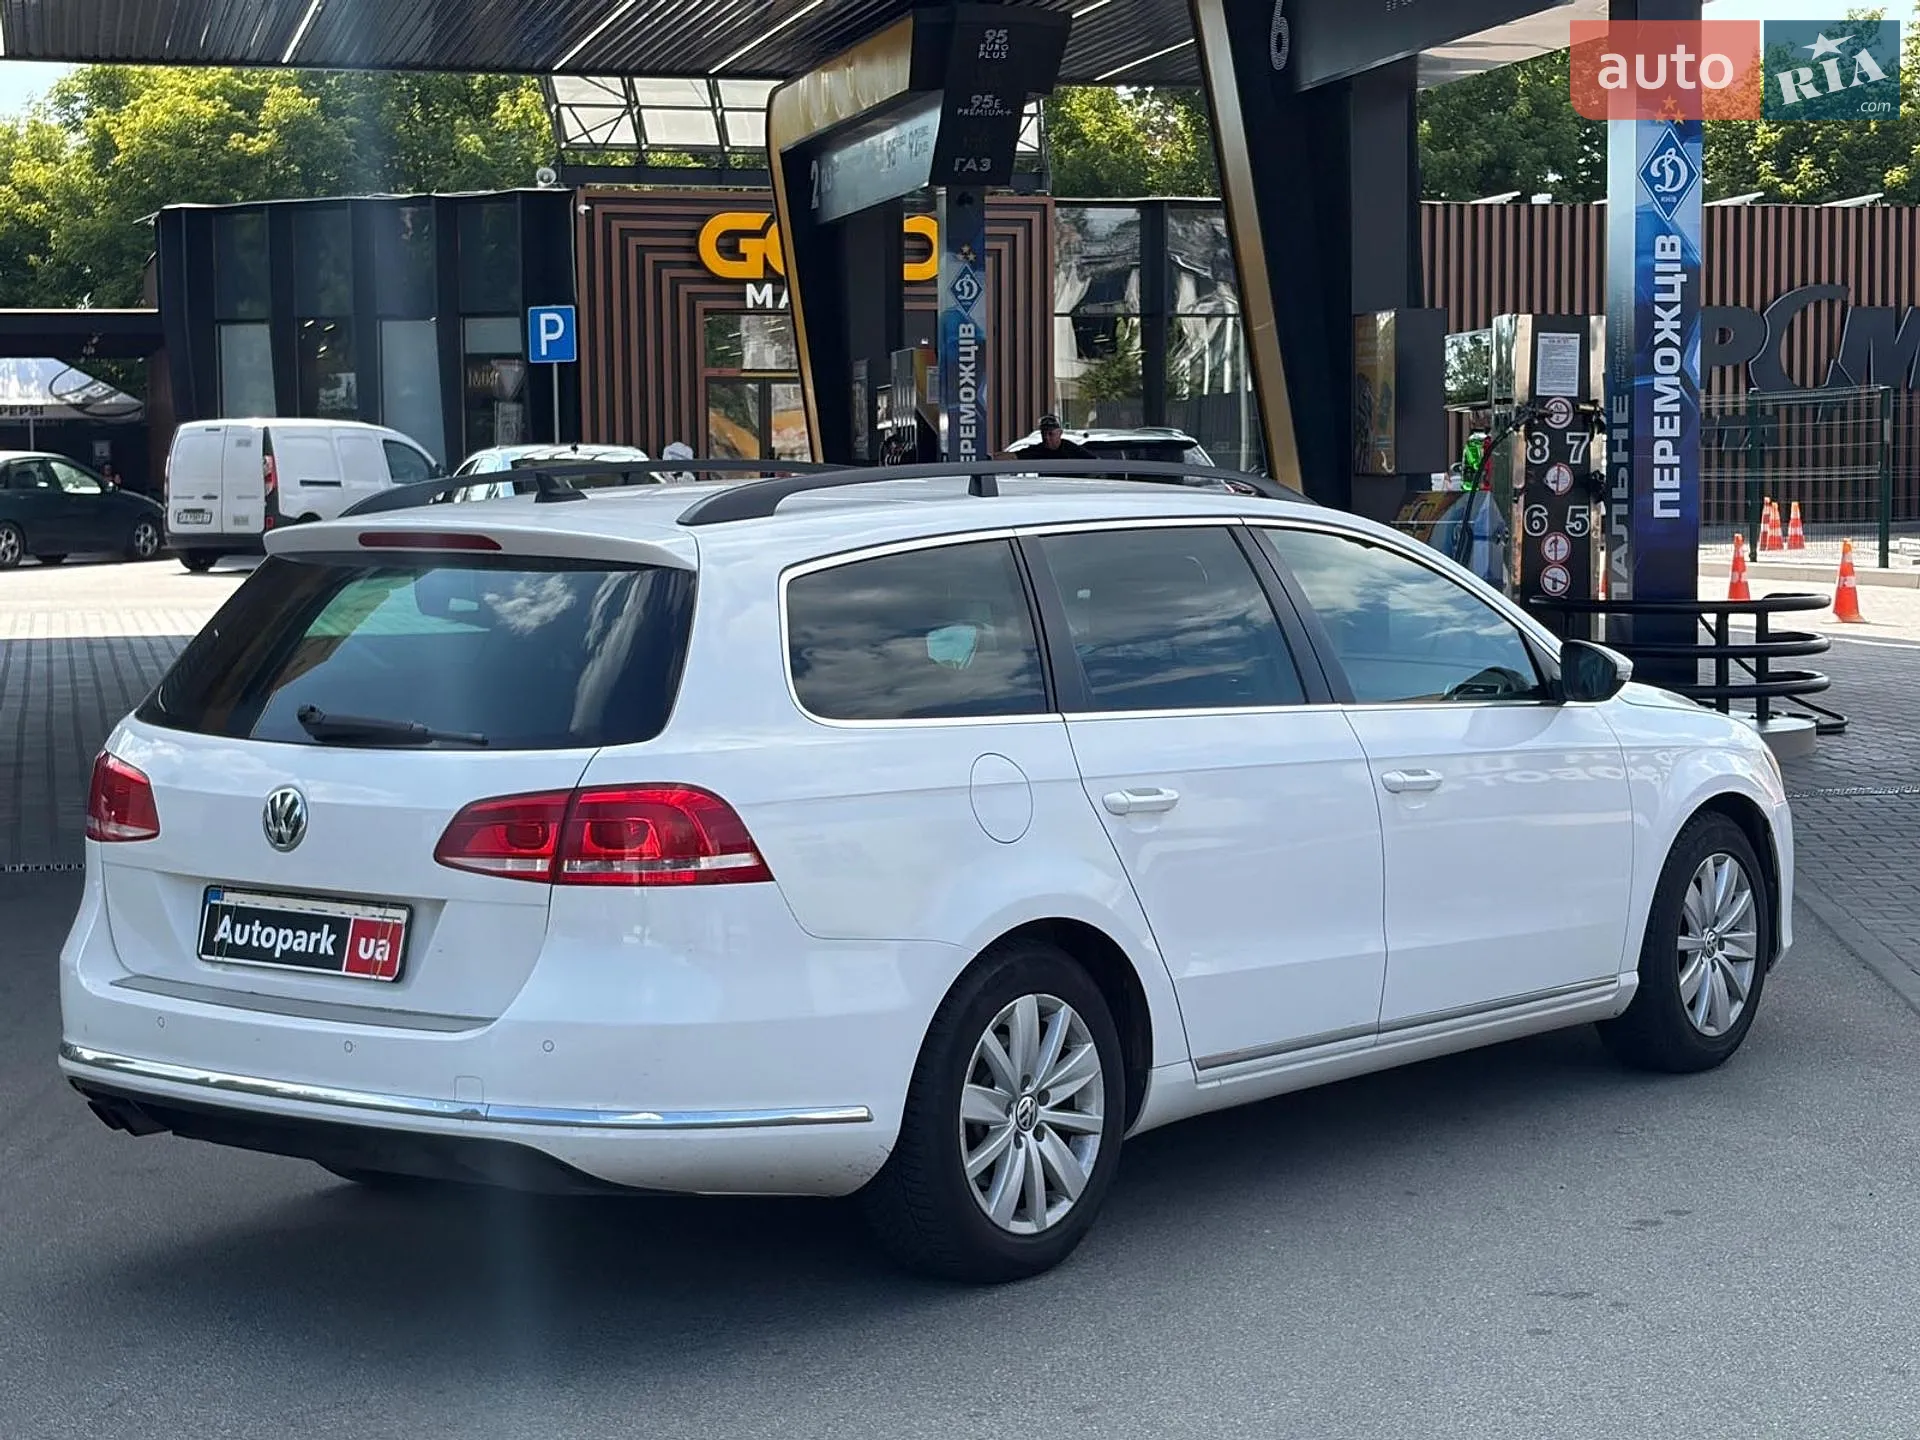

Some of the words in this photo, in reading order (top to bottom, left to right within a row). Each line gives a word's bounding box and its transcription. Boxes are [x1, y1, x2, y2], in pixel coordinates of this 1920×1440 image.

[980, 43, 1009, 51] EURO
[984, 29, 1009, 44] 95
[978, 50, 1007, 59] PLUS
[957, 107, 1013, 117] PREMIUM+
[953, 157, 993, 173] ГАЗ
[539, 312, 565, 356] P
[1654, 234, 1688, 518] ПЕРЕМОЖЦІВ
[1526, 431, 1550, 464] 8
[1566, 432, 1590, 464] 7
[1524, 504, 1549, 537] 6
[1565, 505, 1590, 537] 5
[213, 914, 338, 958] Autopark
[357, 936, 392, 962] ua
